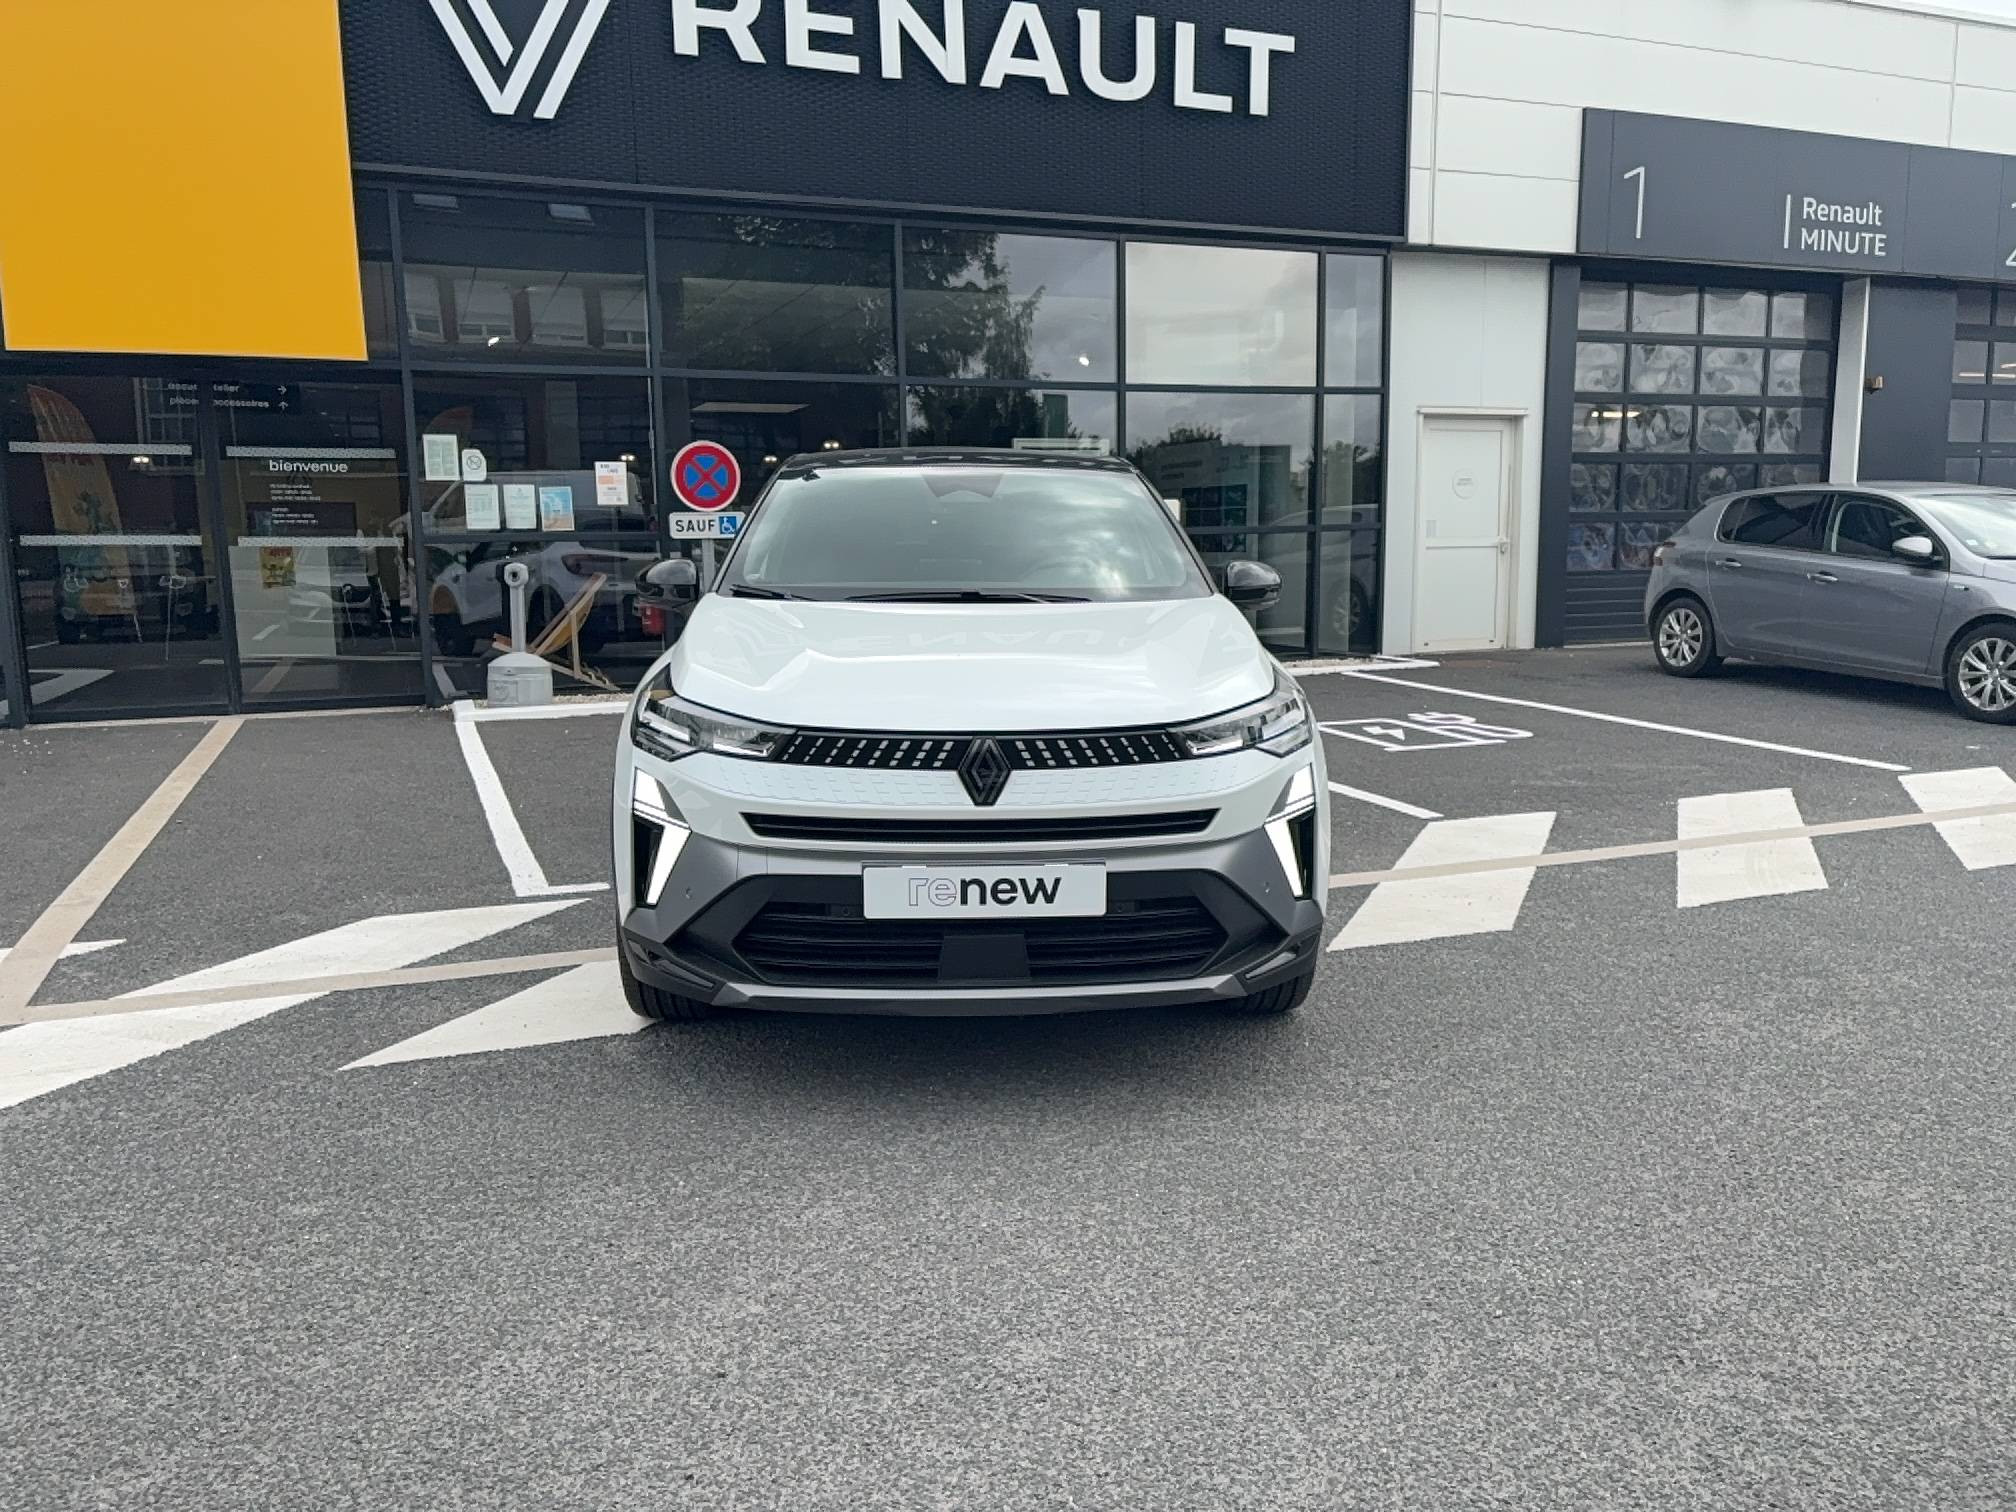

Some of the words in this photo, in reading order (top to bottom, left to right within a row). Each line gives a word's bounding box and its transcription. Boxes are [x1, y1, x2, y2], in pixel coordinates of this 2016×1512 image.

[672, 0, 1296, 117] RENAULT
[1623, 166, 1645, 240] 1
[1802, 197, 1883, 226] Renault
[1799, 227, 1887, 257] MINUTE
[269, 459, 349, 473] bienvenue
[675, 519, 715, 533] SAUF
[908, 876, 1062, 907] renew
